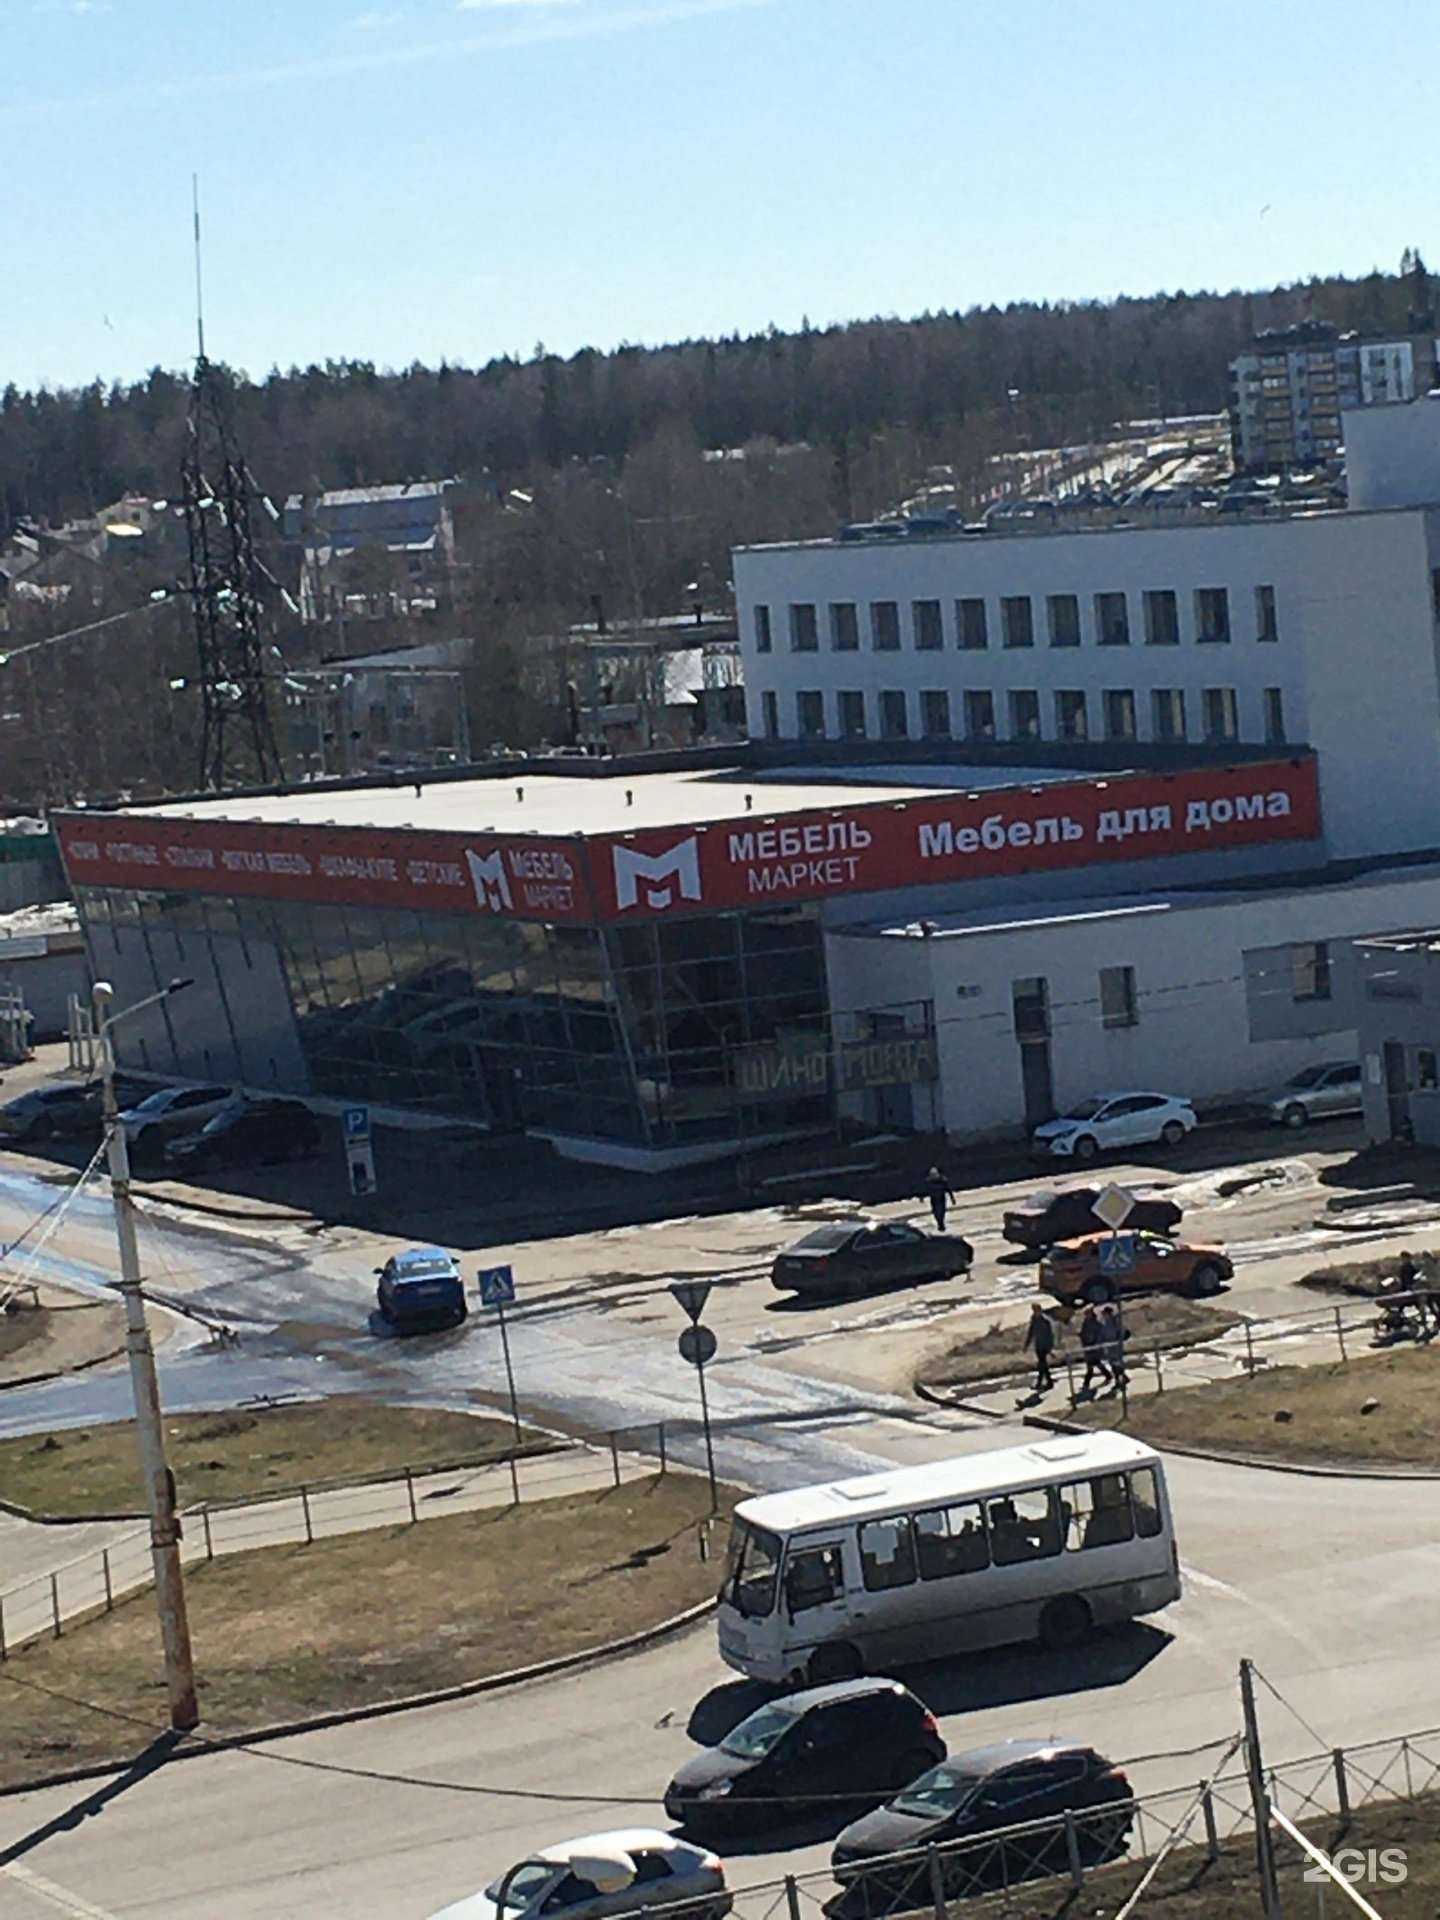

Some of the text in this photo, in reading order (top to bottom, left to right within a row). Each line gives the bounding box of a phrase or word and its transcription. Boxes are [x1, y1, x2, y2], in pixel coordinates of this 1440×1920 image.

[729, 821, 872, 862] МЕБЕЛЬ
[918, 791, 1291, 857] Мебель для дома
[748, 857, 860, 893] МАРКЕТ
[347, 1111, 363, 1131] P
